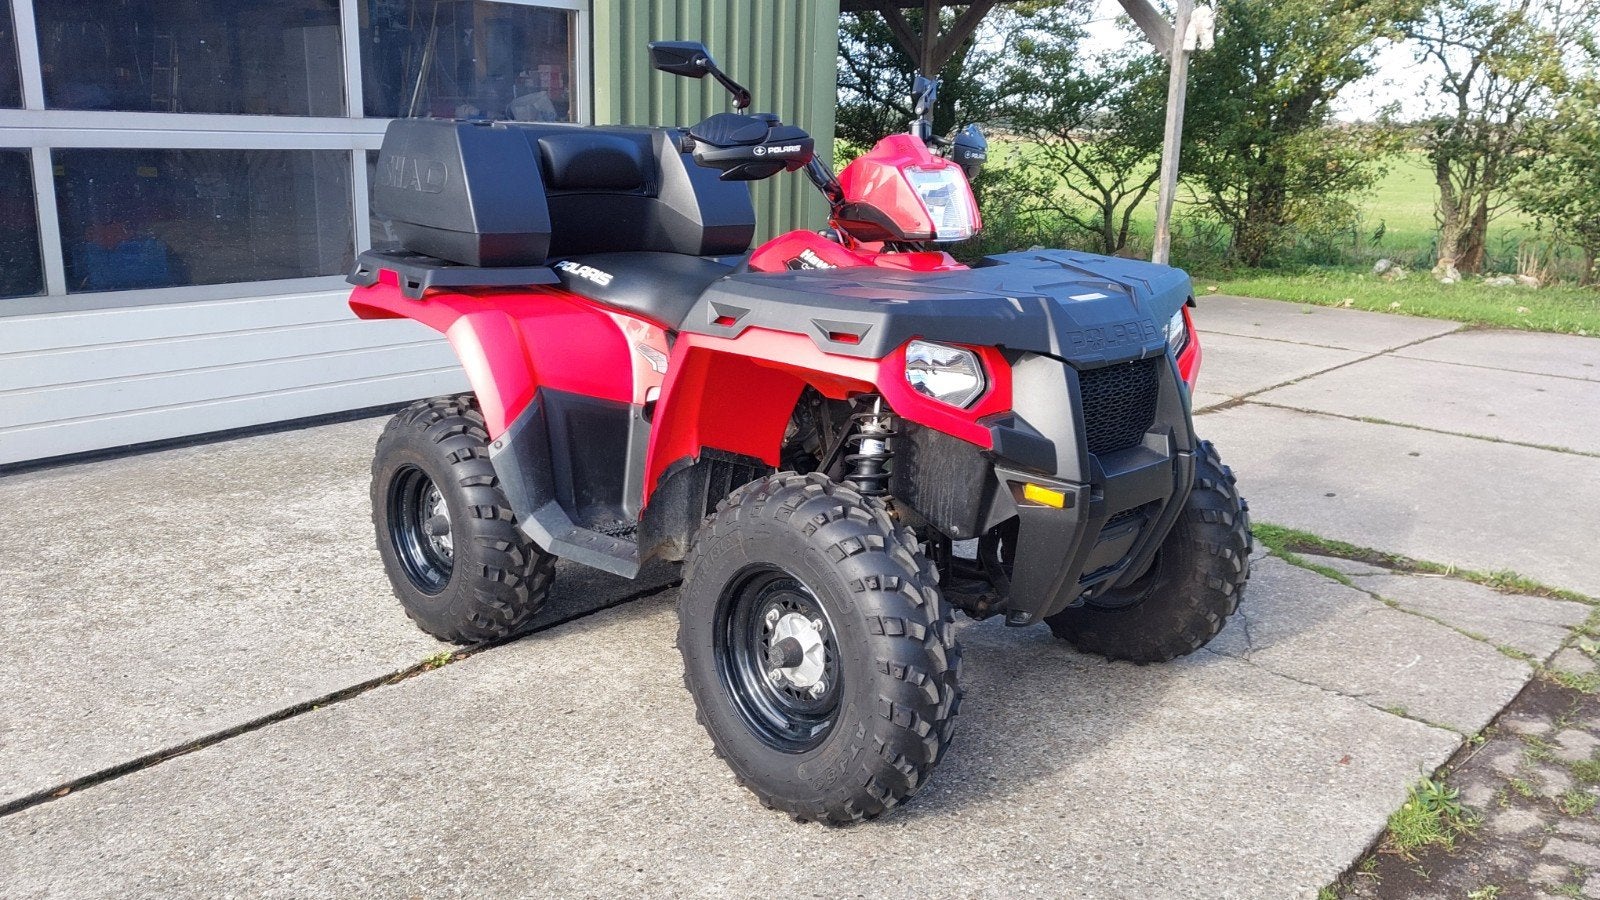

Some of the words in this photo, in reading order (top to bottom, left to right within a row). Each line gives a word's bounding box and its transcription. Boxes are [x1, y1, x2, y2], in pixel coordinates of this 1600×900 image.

[767, 144, 801, 154] POLARIS
[553, 260, 614, 286] POLARIS
[1066, 318, 1158, 355] POLARIS
